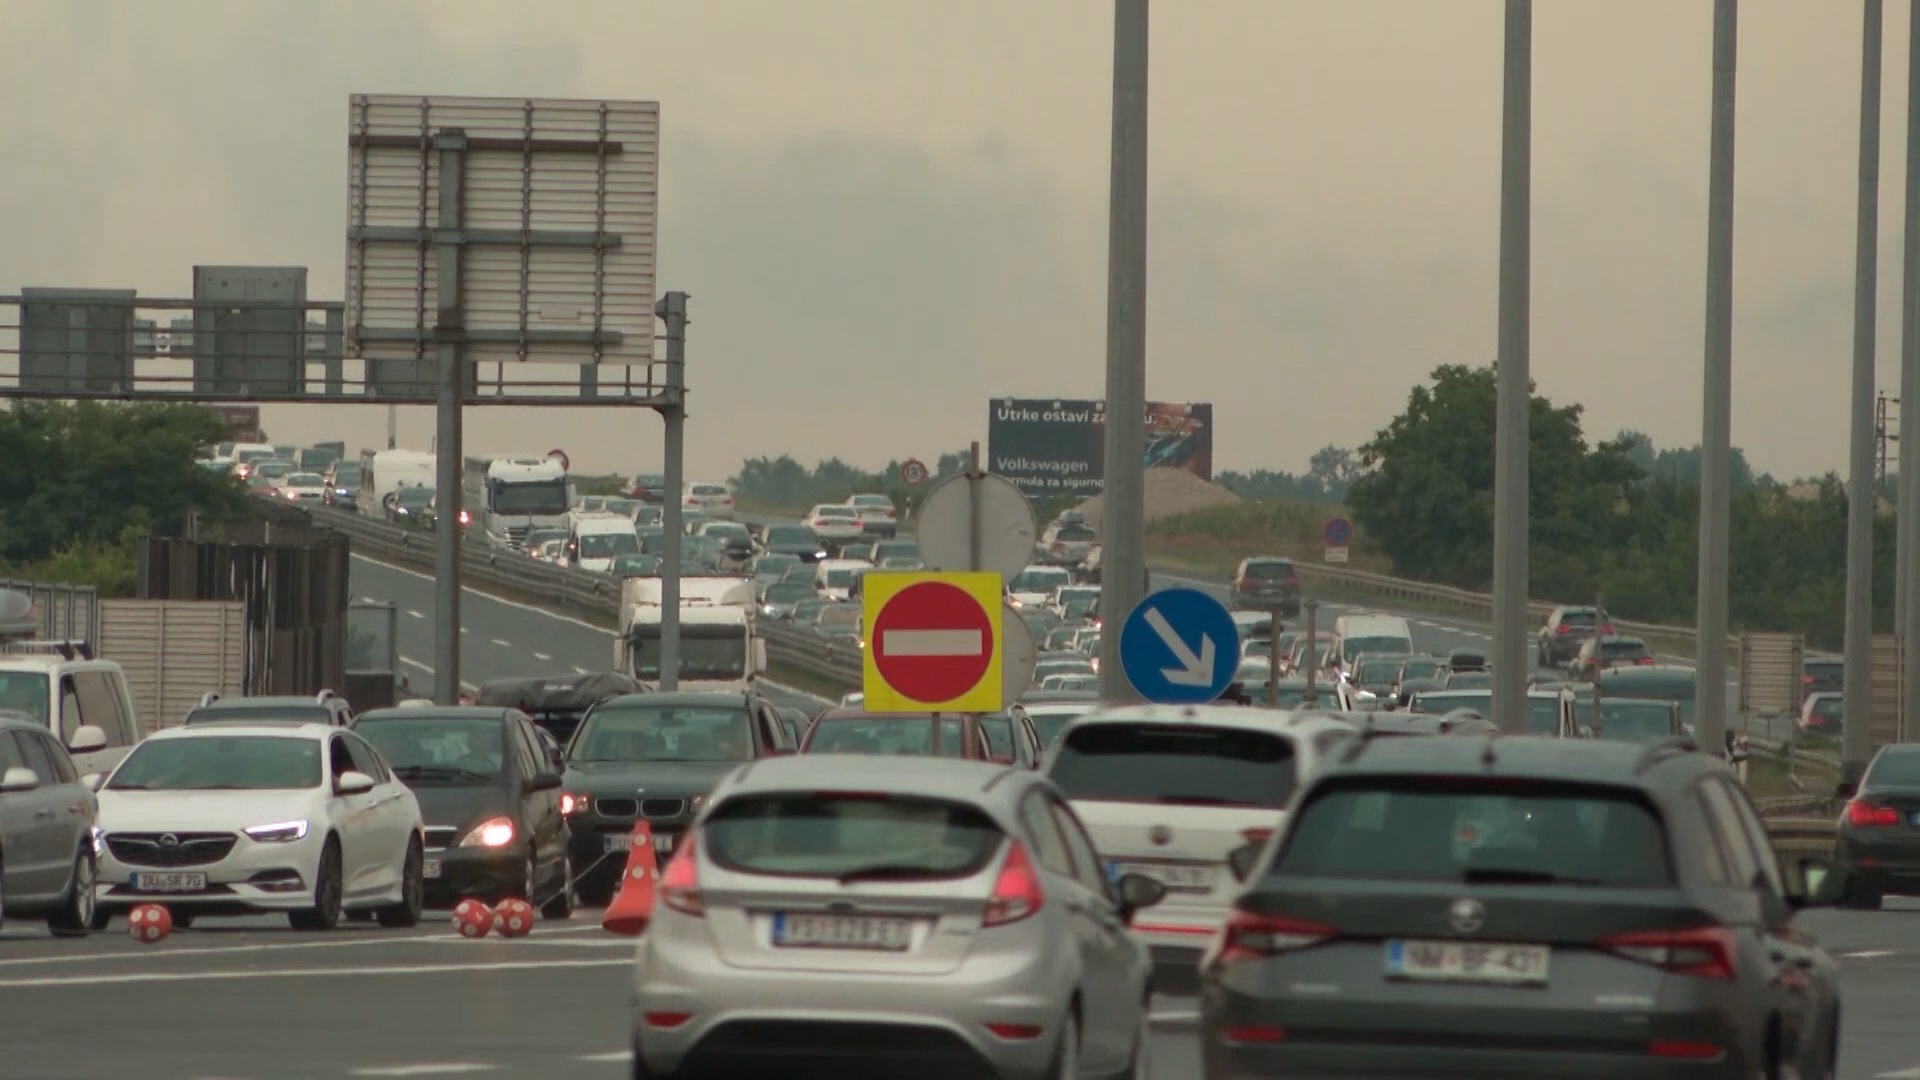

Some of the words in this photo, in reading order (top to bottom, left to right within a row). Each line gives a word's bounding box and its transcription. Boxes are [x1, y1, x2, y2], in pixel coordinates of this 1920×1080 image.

[998, 408, 1039, 421] Utrke
[1043, 409, 1088, 422] ostavi
[997, 457, 1088, 475] Volkswagen
